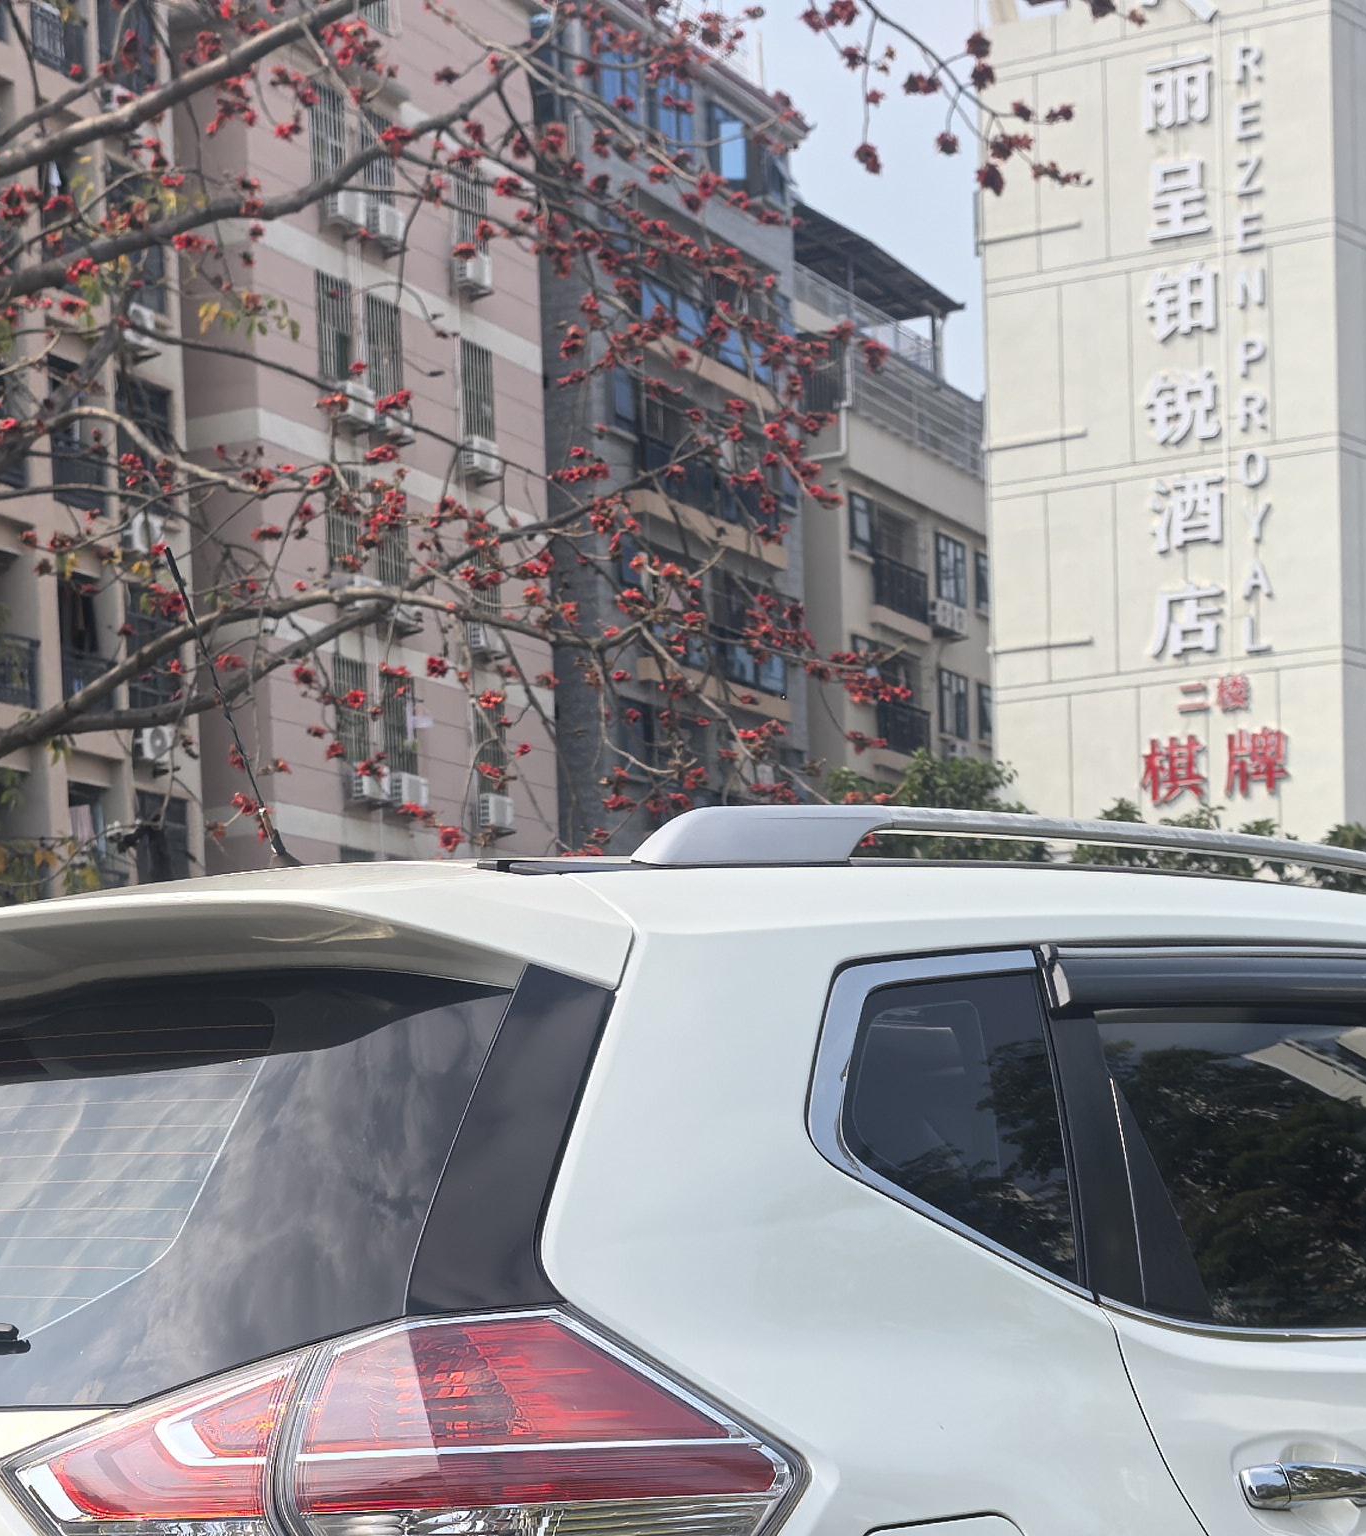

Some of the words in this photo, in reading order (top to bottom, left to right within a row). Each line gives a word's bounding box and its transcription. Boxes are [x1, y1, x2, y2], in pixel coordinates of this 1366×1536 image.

[1236, 45, 1267, 310] REZEN
[1143, 50, 1225, 659] 丽呈铂锐酒店
[1140, 727, 1291, 807] 棋牌
[1177, 673, 1251, 714] 二楼
